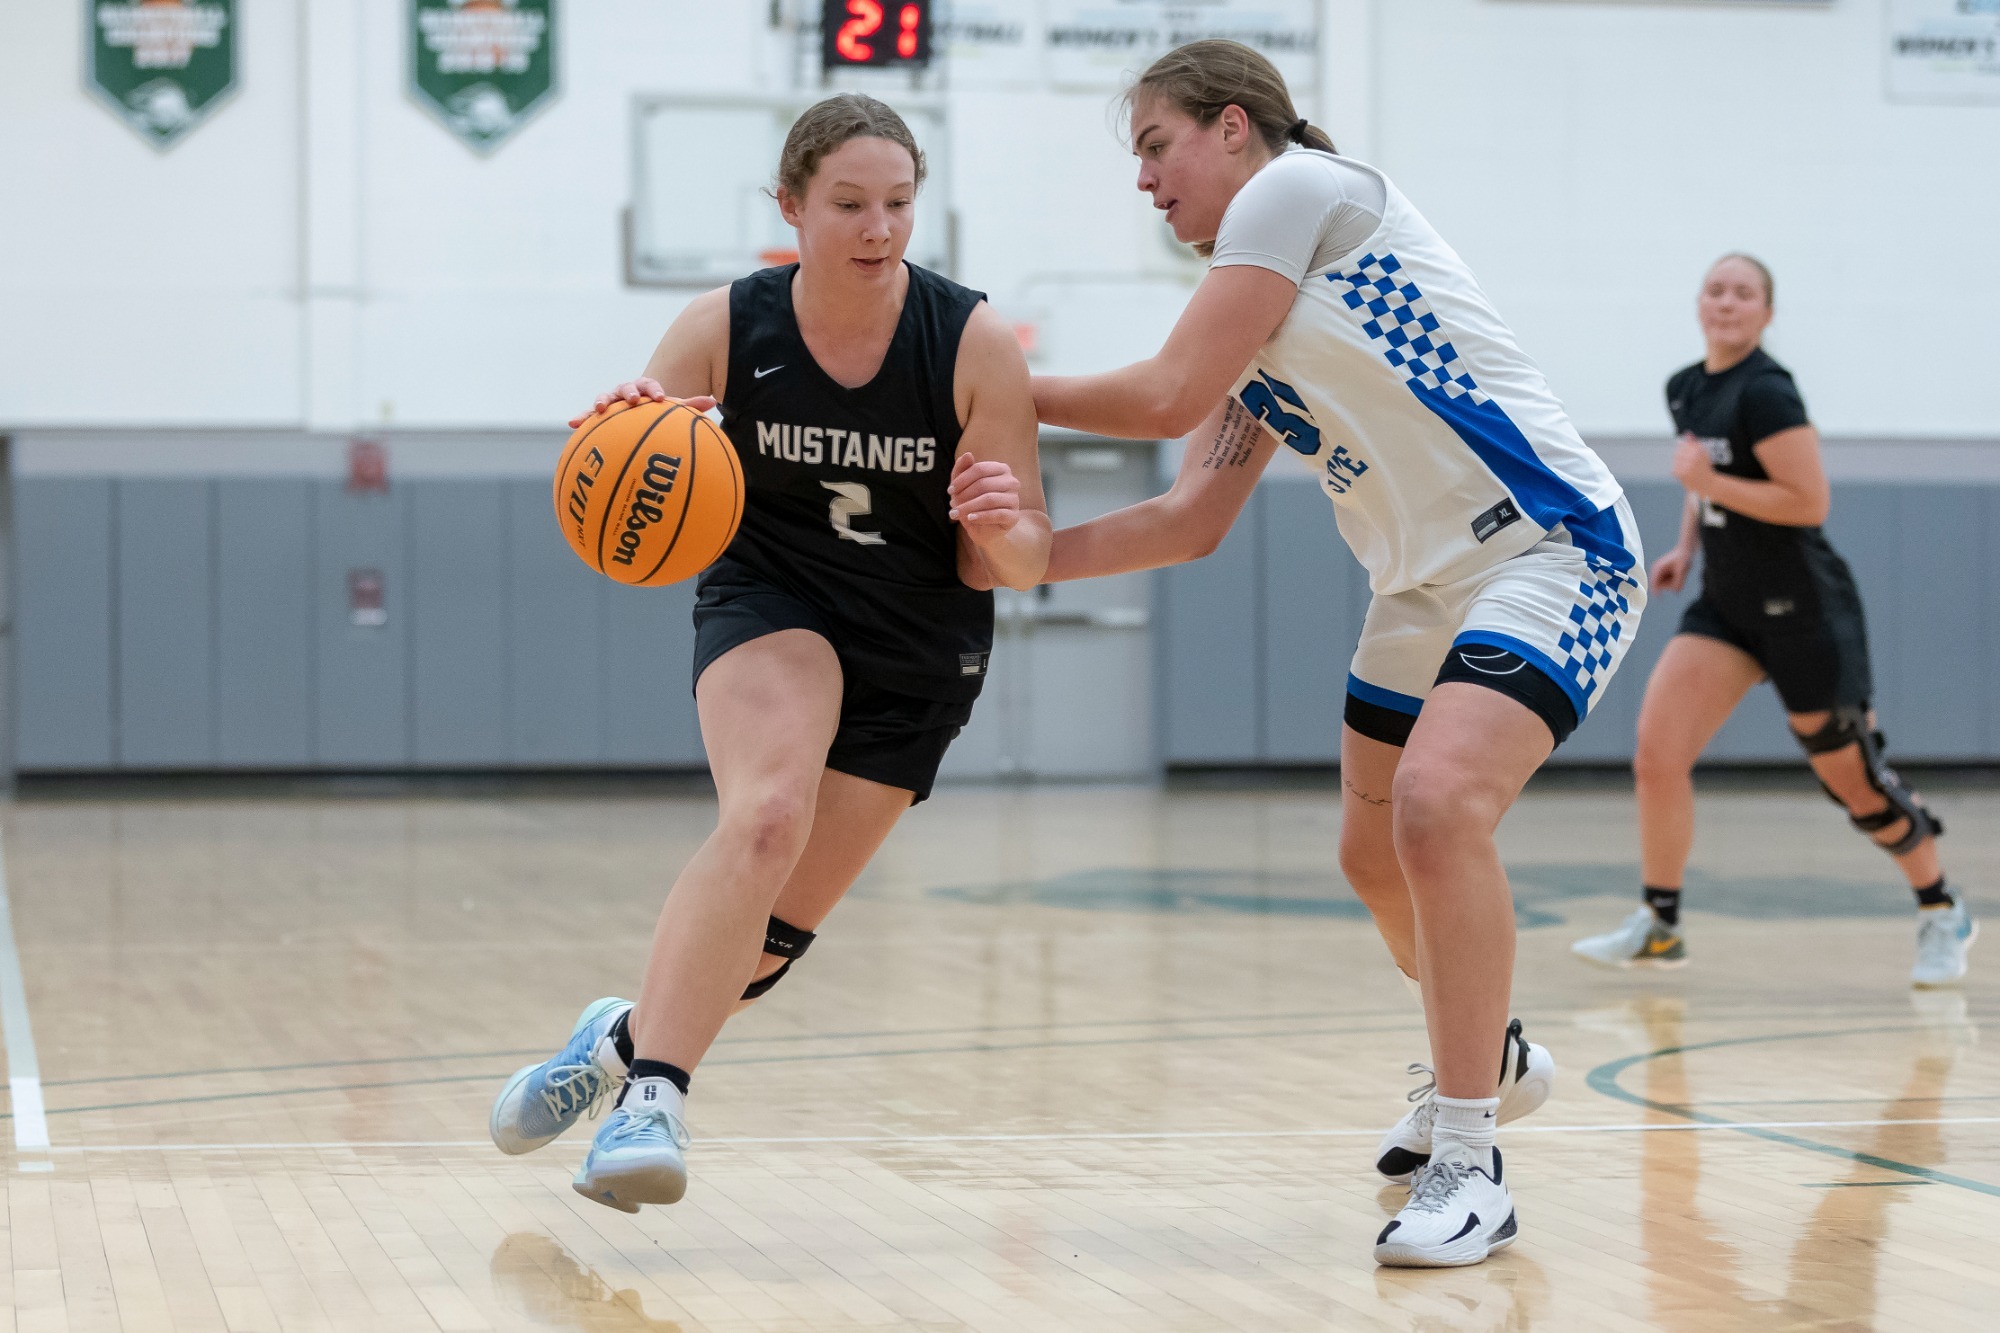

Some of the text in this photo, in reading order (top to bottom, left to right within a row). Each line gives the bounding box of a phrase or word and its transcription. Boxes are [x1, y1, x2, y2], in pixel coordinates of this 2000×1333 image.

[835, 0, 920, 62] 21
[756, 420, 936, 473] MUSTANGS
[1202, 456, 1213, 469] The
[1210, 438, 1221, 456] Lord
[1214, 456, 1225, 470] will
[1222, 445, 1230, 457] not
[1226, 431, 1236, 446] fear
[1229, 451, 1239, 466] man
[1235, 441, 1244, 451] do
[1238, 447, 1252, 468] Psalm
[569, 446, 604, 525] EVO
[612, 452, 681, 566] Wilson
[819, 480, 887, 545] 2
[1498, 507, 1512, 520] XL
